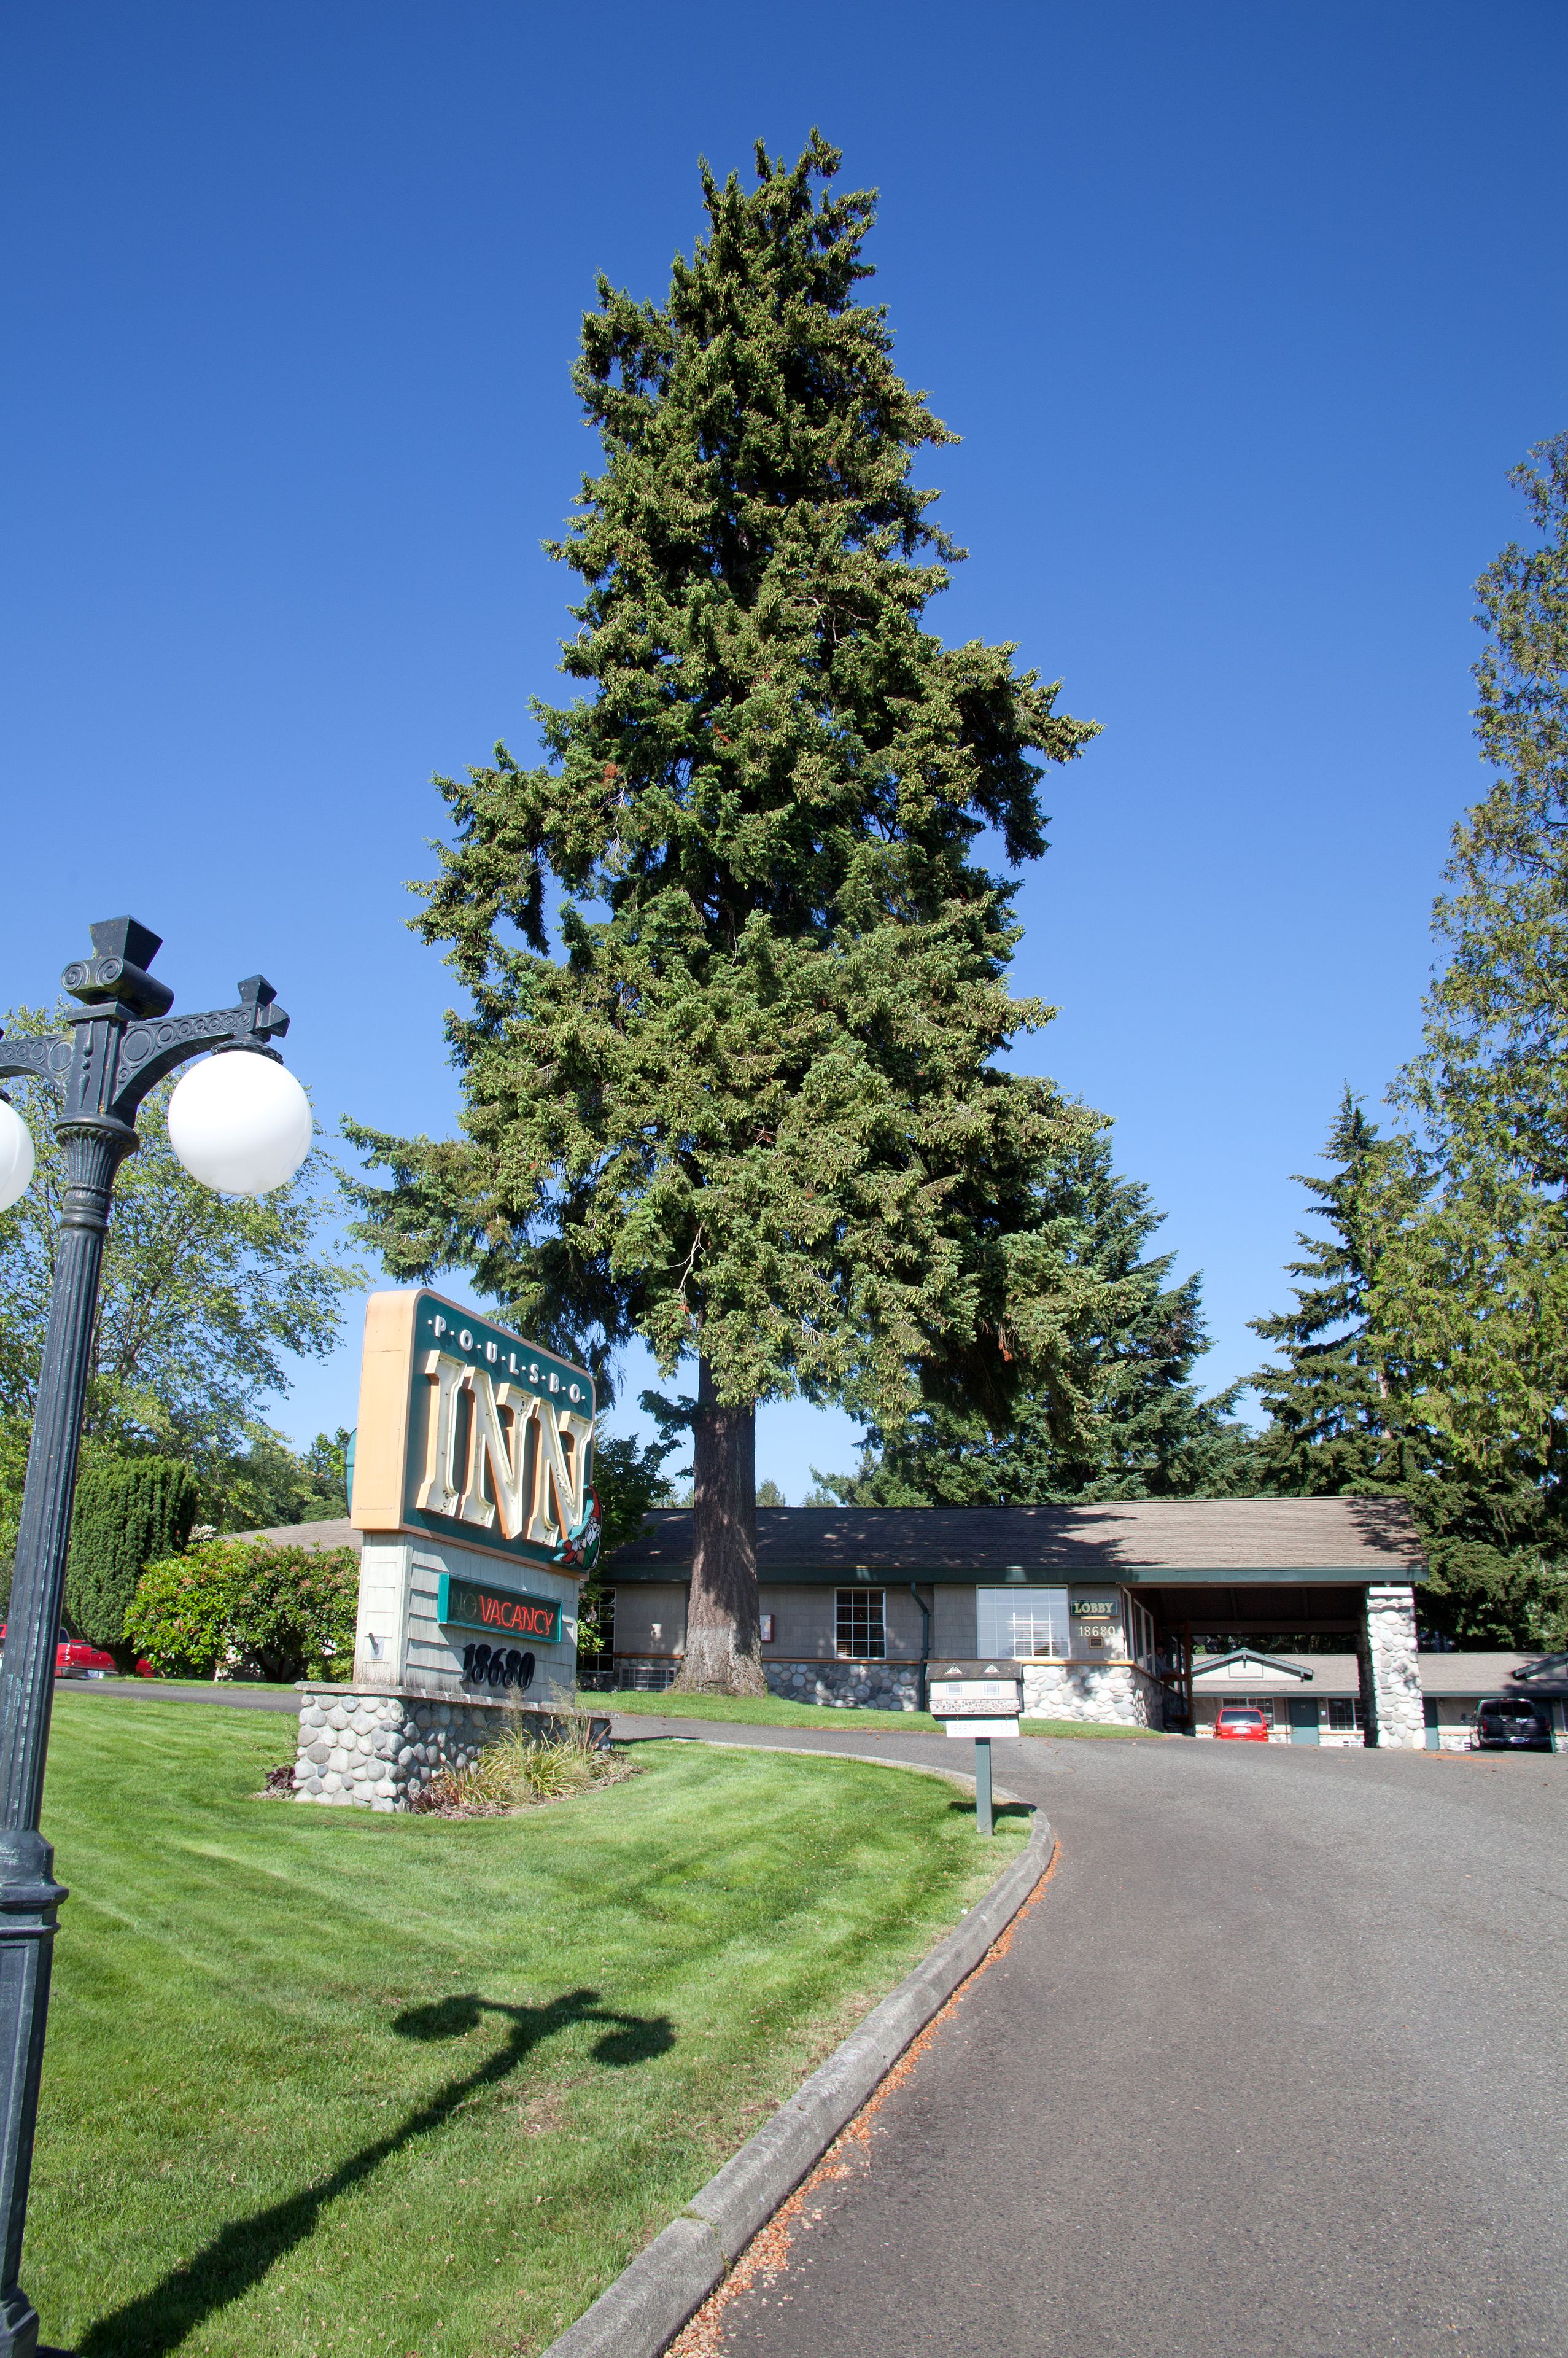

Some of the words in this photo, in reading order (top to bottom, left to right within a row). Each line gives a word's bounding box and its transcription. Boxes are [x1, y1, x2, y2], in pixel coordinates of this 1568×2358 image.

[416, 1350, 593, 1547] INN
[480, 1595, 553, 1635] VACANCY
[1074, 1602, 1114, 1614] LOBBY
[1079, 1625, 1116, 1637] 18680
[459, 1643, 535, 1691] 18680
